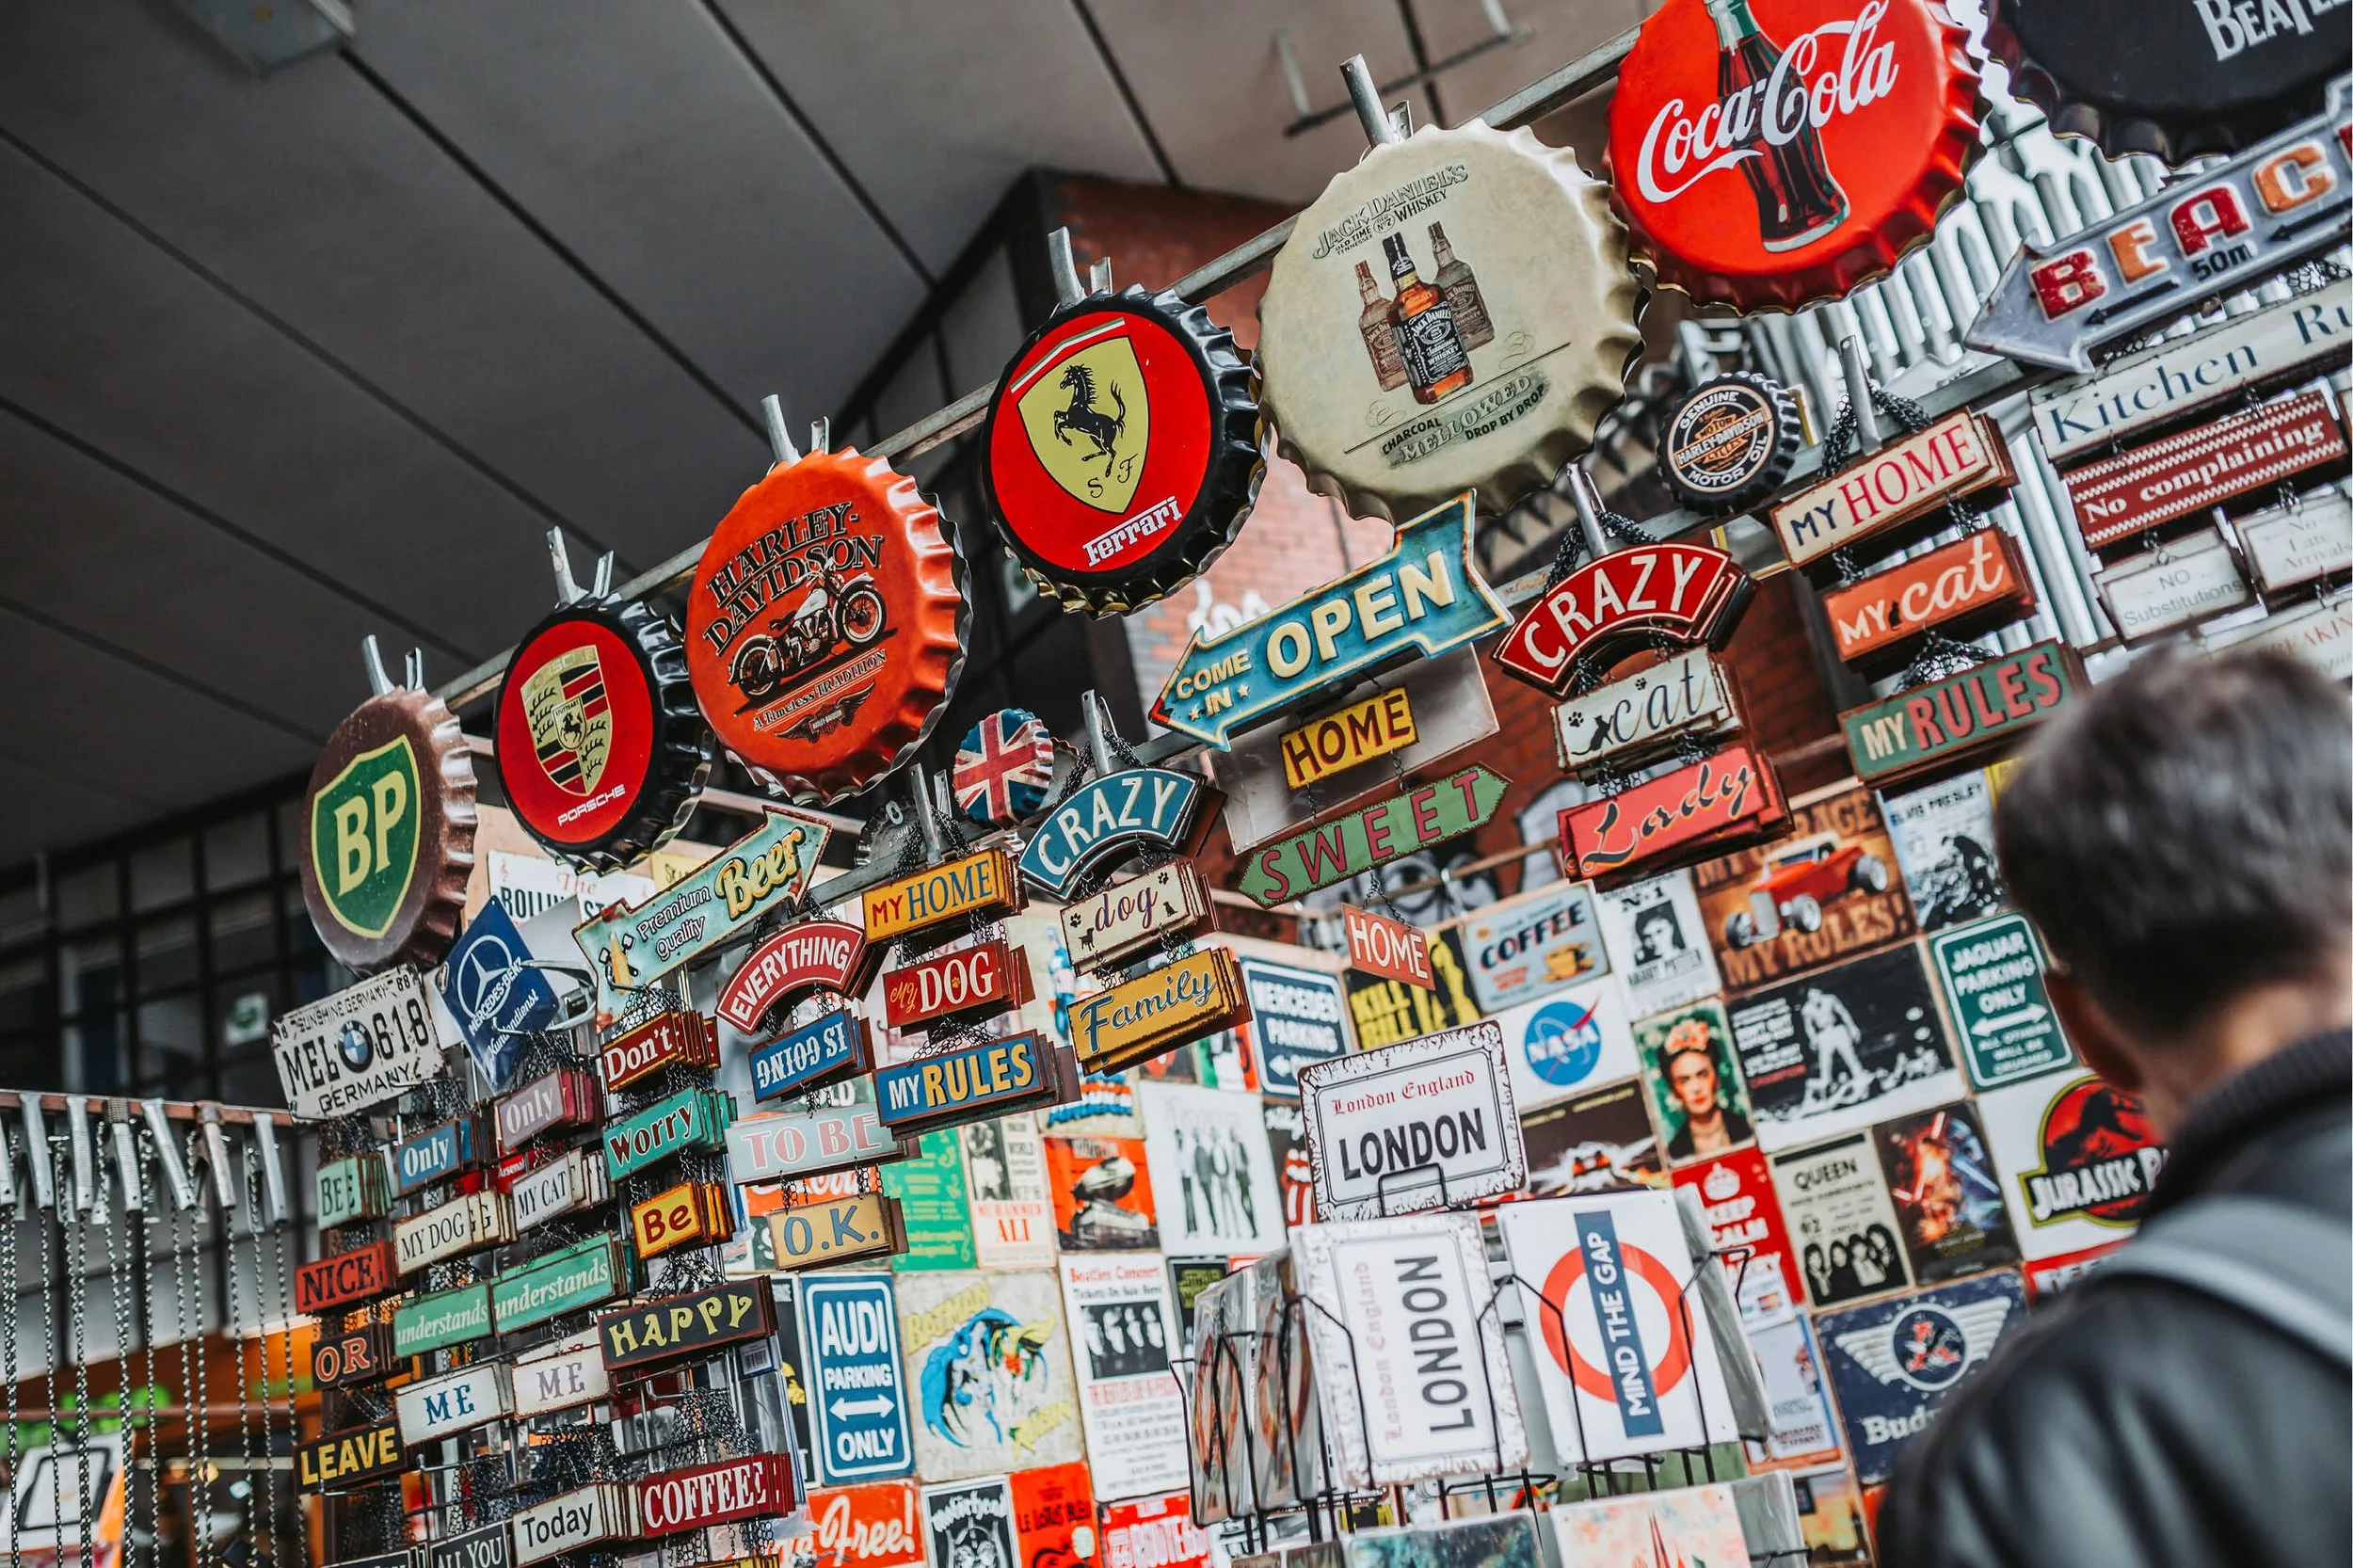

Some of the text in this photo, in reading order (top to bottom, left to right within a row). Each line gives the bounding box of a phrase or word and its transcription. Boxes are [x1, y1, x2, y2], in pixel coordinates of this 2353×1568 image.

[1637, 1, 1899, 203] Coca-Cola
[1313, 165, 1468, 259] JACK DANIEL'S
[1394, 189, 1448, 222] WHISKEY
[2031, 124, 2353, 323] BEAC
[1336, 225, 1372, 252] OLD TIME
[1337, 234, 1373, 255] TENNESSEE
[2191, 241, 2253, 281] 50m
[1400, 376, 1531, 462] MELLOWED
[1465, 384, 1545, 440] DROP BY DROP
[1680, 392, 1739, 429] GENUINE
[2049, 344, 2258, 444] Kitchen
[1382, 418, 1443, 455] CHARCOAL
[1677, 412, 1764, 465] HARLEY-DAVIDSON
[1700, 417, 1733, 438] MOTOR
[1707, 440, 1742, 460] CYCLES
[1087, 477, 1103, 498] S
[1689, 436, 1768, 487] MOTOR OIL
[1790, 424, 1977, 546] MY HOME
[2083, 420, 2325, 523] No complaining
[707, 502, 858, 609] HARLEY-
[1082, 495, 1182, 567] Ferrari
[704, 536, 884, 656] DAVIDSON
[1837, 536, 2004, 646] MY cat
[2124, 579, 2244, 627] Substitutions
[2159, 568, 2190, 589] NO
[1266, 549, 1456, 679] OPEN
[1525, 553, 1704, 667] CRAZY
[753, 717, 762, 731] A
[763, 690, 815, 724] Timeless
[815, 648, 888, 697] TRADITION
[1176, 648, 1253, 700] COME
[1206, 685, 1234, 716] IN
[1612, 658, 1707, 744] cat
[1861, 652, 2062, 760] MY RULES
[1285, 693, 1414, 783] HOME
[557, 784, 626, 826] PORSCHE
[1037, 776, 1178, 876] CRAZY
[334, 769, 408, 896] BP
[1260, 771, 1480, 899] SWEET
[715, 827, 806, 921] Beer
[872, 859, 993, 927] MY HOME
[637, 885, 711, 941] Premium
[1094, 885, 1159, 930] dog
[655, 916, 706, 962] Quality
[1349, 913, 1428, 980] HOME
[1480, 900, 1585, 971] COFFEE
[1721, 941, 1781, 986] MY
[1781, 893, 1909, 968] RULES!
[1951, 932, 2028, 974] JAGUAR
[732, 936, 849, 1022] EVERYTHING
[918, 951, 993, 1015] DOG
[1350, 979, 1412, 1020] KILL
[1955, 955, 2036, 997] PARKING
[1978, 982, 2027, 1015] ONLY
[296, 1000, 344, 1032] SUNSHINE
[345, 982, 388, 1013] GERMANY
[373, 999, 429, 1060] 618
[1080, 968, 1217, 1053] Family
[603, 1024, 673, 1082] Don't
[1266, 1017, 1338, 1053] PARKING
[1529, 1023, 1599, 1064] NASA
[318, 1063, 409, 1114] GERMANY
[888, 1074, 919, 1110] MY
[921, 1043, 1034, 1109] RULES
[1332, 1070, 1475, 1115] London England
[504, 1086, 553, 1135] Only
[610, 1102, 693, 1168] Worry
[404, 1136, 450, 1177] Only
[498, 1157, 525, 1178] Arsenal
[741, 1112, 881, 1170] TO BE
[1339, 1107, 1487, 1181] LONDON
[519, 1170, 568, 1219] MY CAT
[1794, 1157, 1858, 1192] QUEEN
[401, 1212, 465, 1262] MY DOG
[642, 1201, 692, 1245] Be
[784, 1205, 879, 1255] O.K.
[302, 1254, 375, 1306] NICE
[494, 1257, 609, 1320] understands
[396, 1302, 488, 1345] understands
[608, 1293, 752, 1357] HAPPY
[822, 1300, 888, 1356] AUDI
[905, 1282, 988, 1355] BATMAN
[1394, 1256, 1475, 1432] LONDON
[1587, 1231, 1650, 1417] MIND THE GAP
[315, 1337, 371, 1383] OR
[824, 1363, 893, 1390] PARKING
[1354, 1262, 1402, 1441] London England
[424, 1384, 475, 1427] ME
[536, 1362, 584, 1402] ME
[301, 1427, 398, 1485] LEAVE
[837, 1428, 895, 1462] ONLY
[468, 1535, 504, 1568] YOU
[522, 1503, 593, 1548] Today
